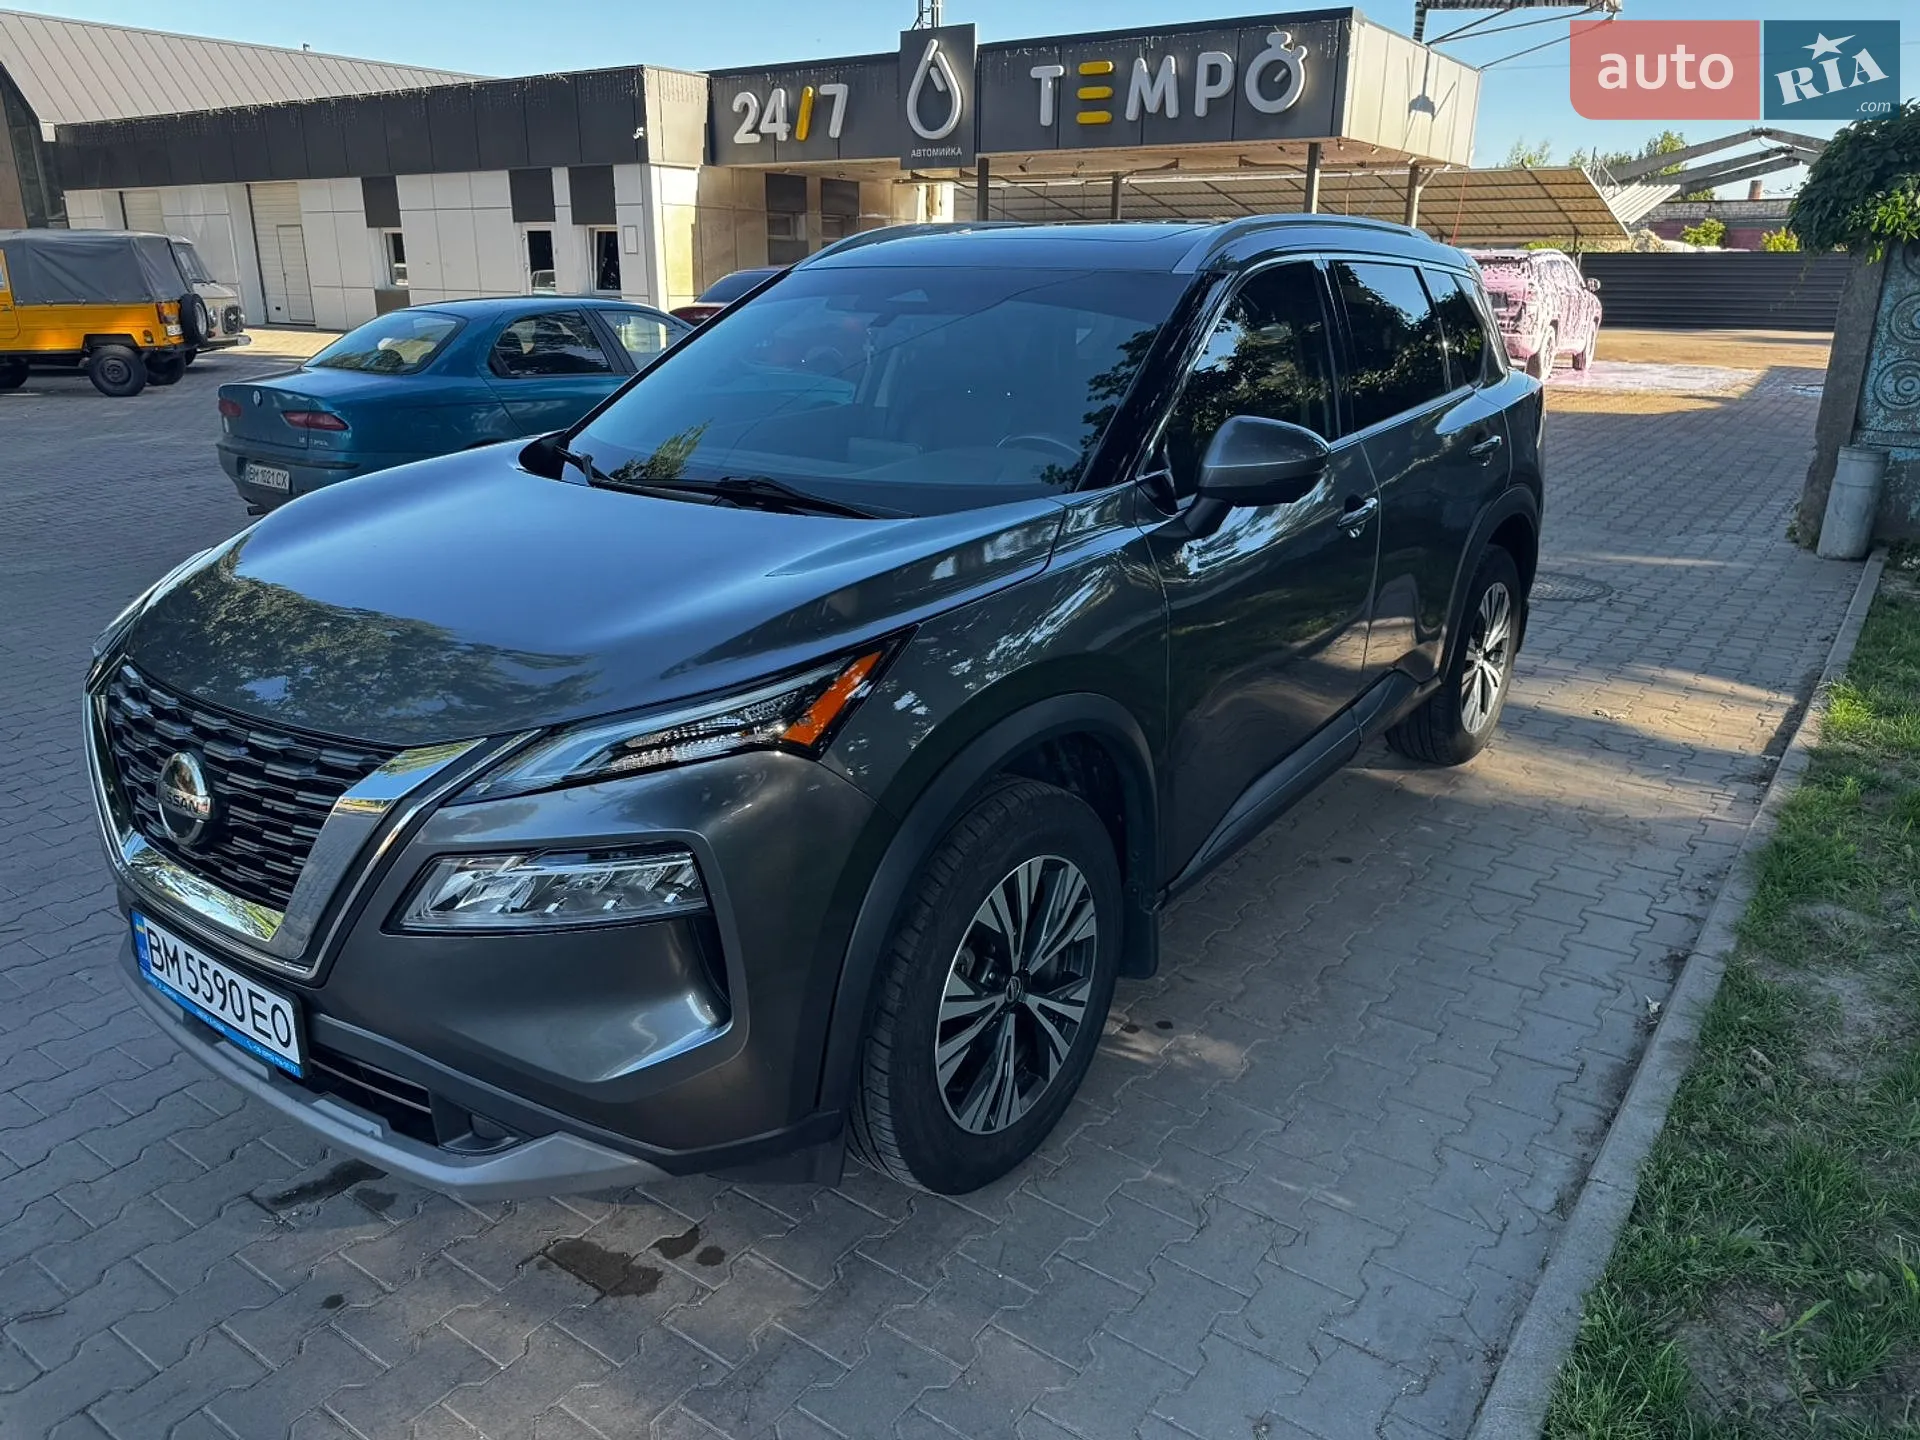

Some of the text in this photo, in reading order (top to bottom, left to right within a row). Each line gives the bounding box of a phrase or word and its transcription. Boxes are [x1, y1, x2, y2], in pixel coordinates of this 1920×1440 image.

[732, 83, 849, 144] 24/7
[1030, 31, 1308, 127] TEMPO
[911, 146, 962, 158] АВТОМИЙКА
[147, 926, 183, 986] BM
[184, 952, 246, 1023] 5590
[247, 988, 292, 1049] EO
